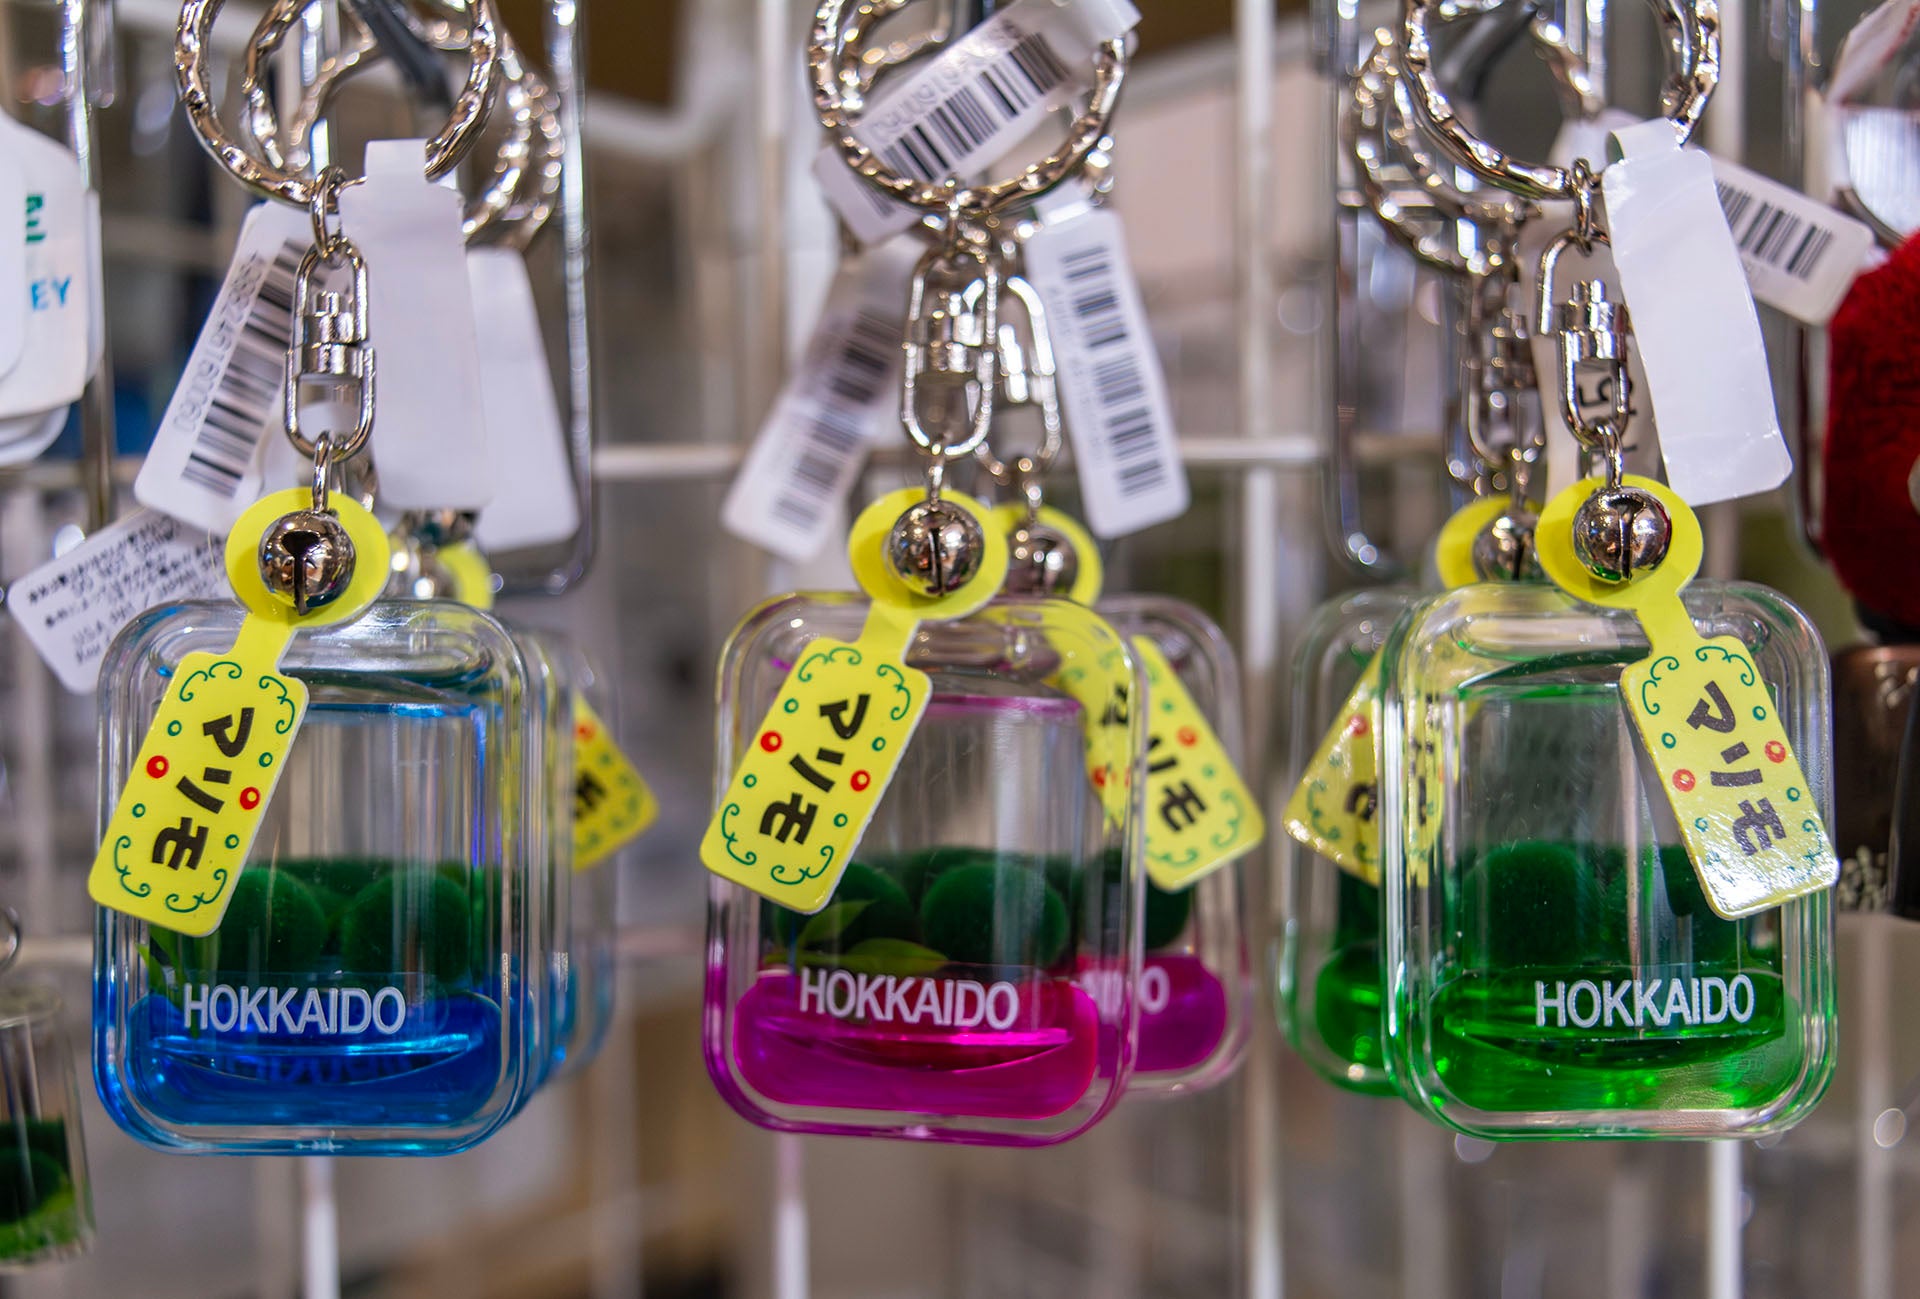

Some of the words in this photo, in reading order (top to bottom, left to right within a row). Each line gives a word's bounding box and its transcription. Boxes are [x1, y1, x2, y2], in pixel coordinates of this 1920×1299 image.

[152, 707, 254, 870] マリモ
[759, 694, 871, 845] マリモ
[1686, 680, 1788, 856] マリモ
[183, 982, 406, 1035] HOKKAIDO
[800, 966, 1019, 1030] HOKKAIDO
[1534, 974, 1755, 1029] HOKKAIDO
